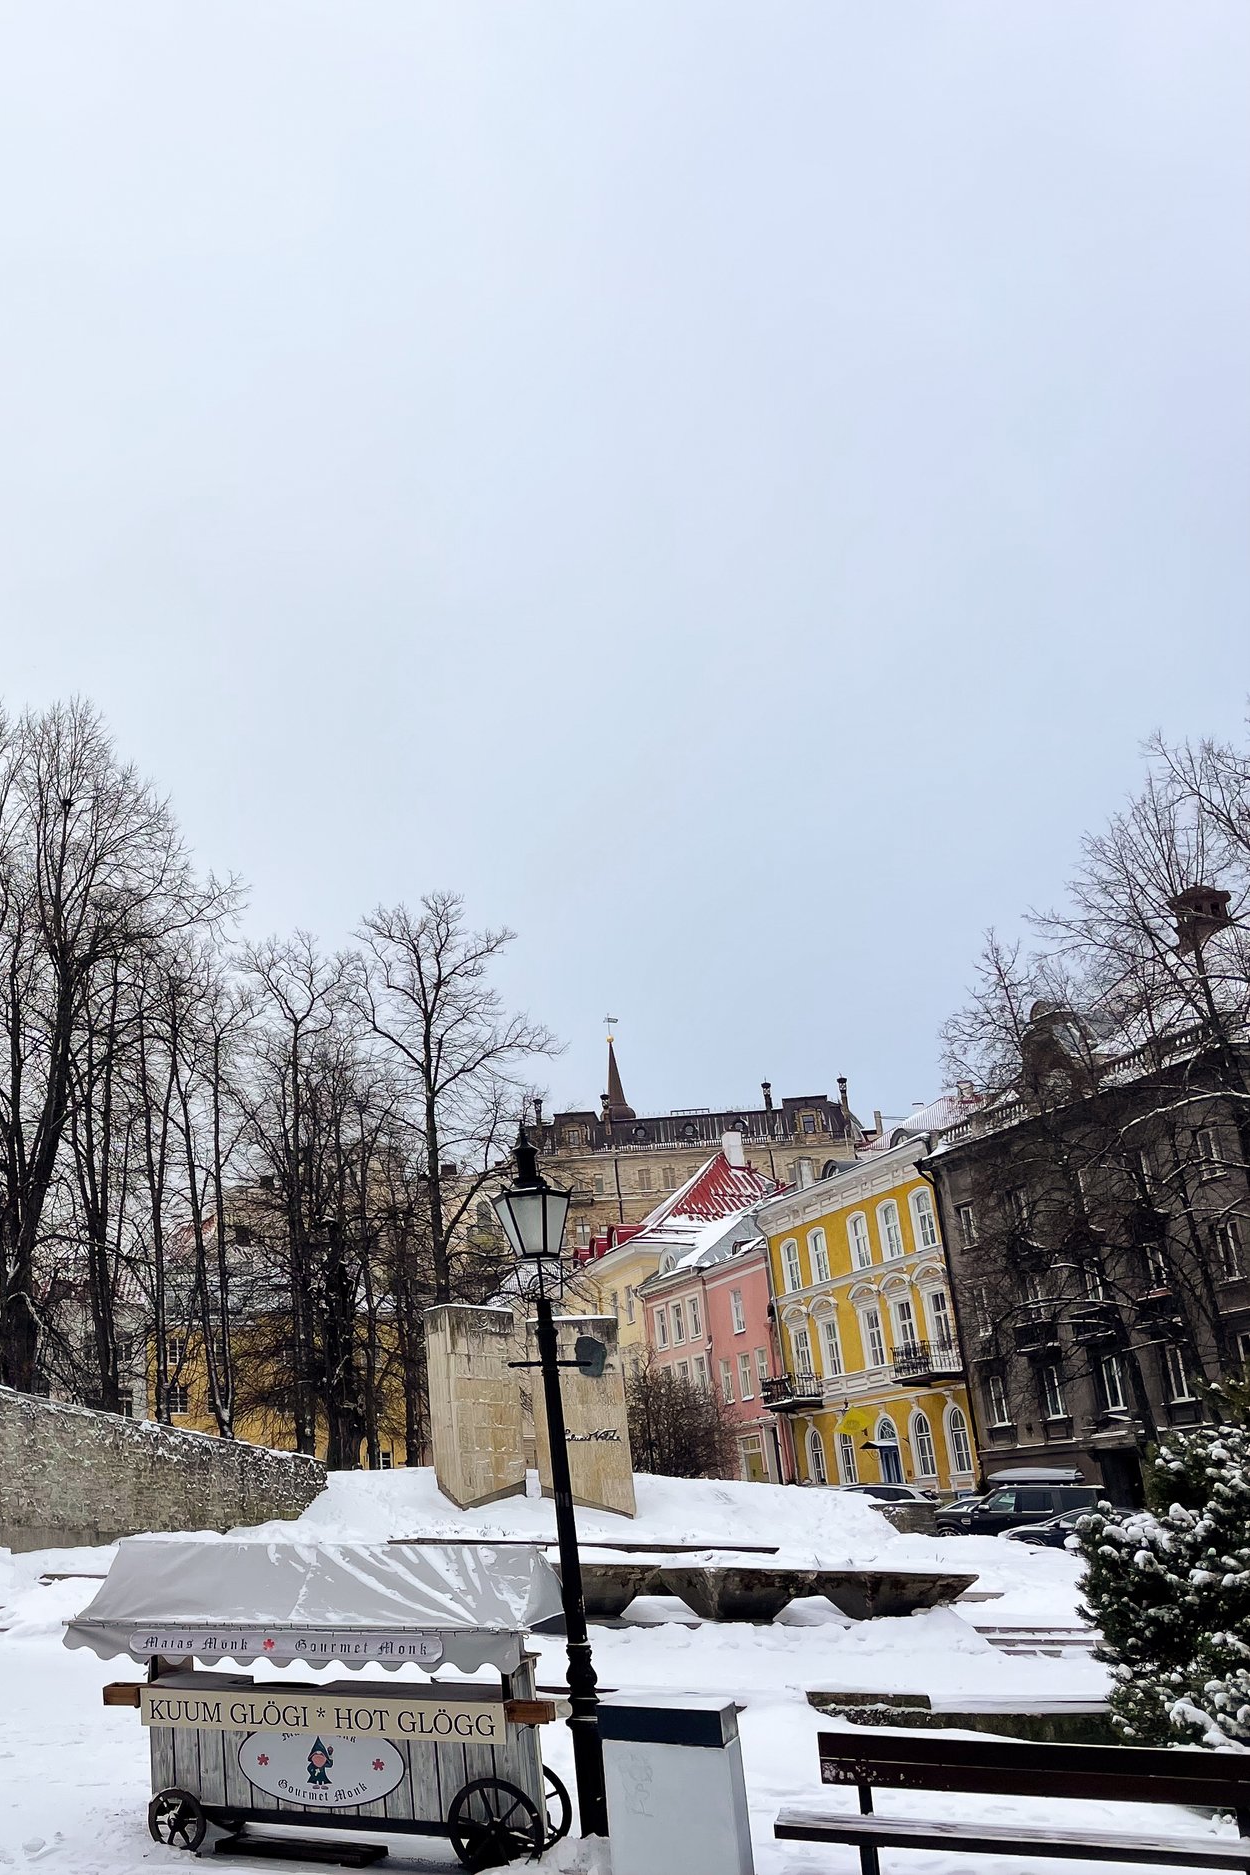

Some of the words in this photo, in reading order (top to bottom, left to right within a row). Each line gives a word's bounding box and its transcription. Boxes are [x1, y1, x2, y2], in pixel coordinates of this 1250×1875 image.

[143, 1636, 194, 1649] Maias
[202, 1637, 248, 1650] Monk
[295, 1639, 368, 1654] Gourmet
[378, 1641, 427, 1655] Monk
[149, 1699, 222, 1723] KUUM
[230, 1701, 310, 1728] GLÖGI
[334, 1708, 390, 1731] HOT
[397, 1709, 496, 1737] GLÖGG
[278, 1779, 328, 1801] Gourmet
[334, 1782, 368, 1802] Monk
